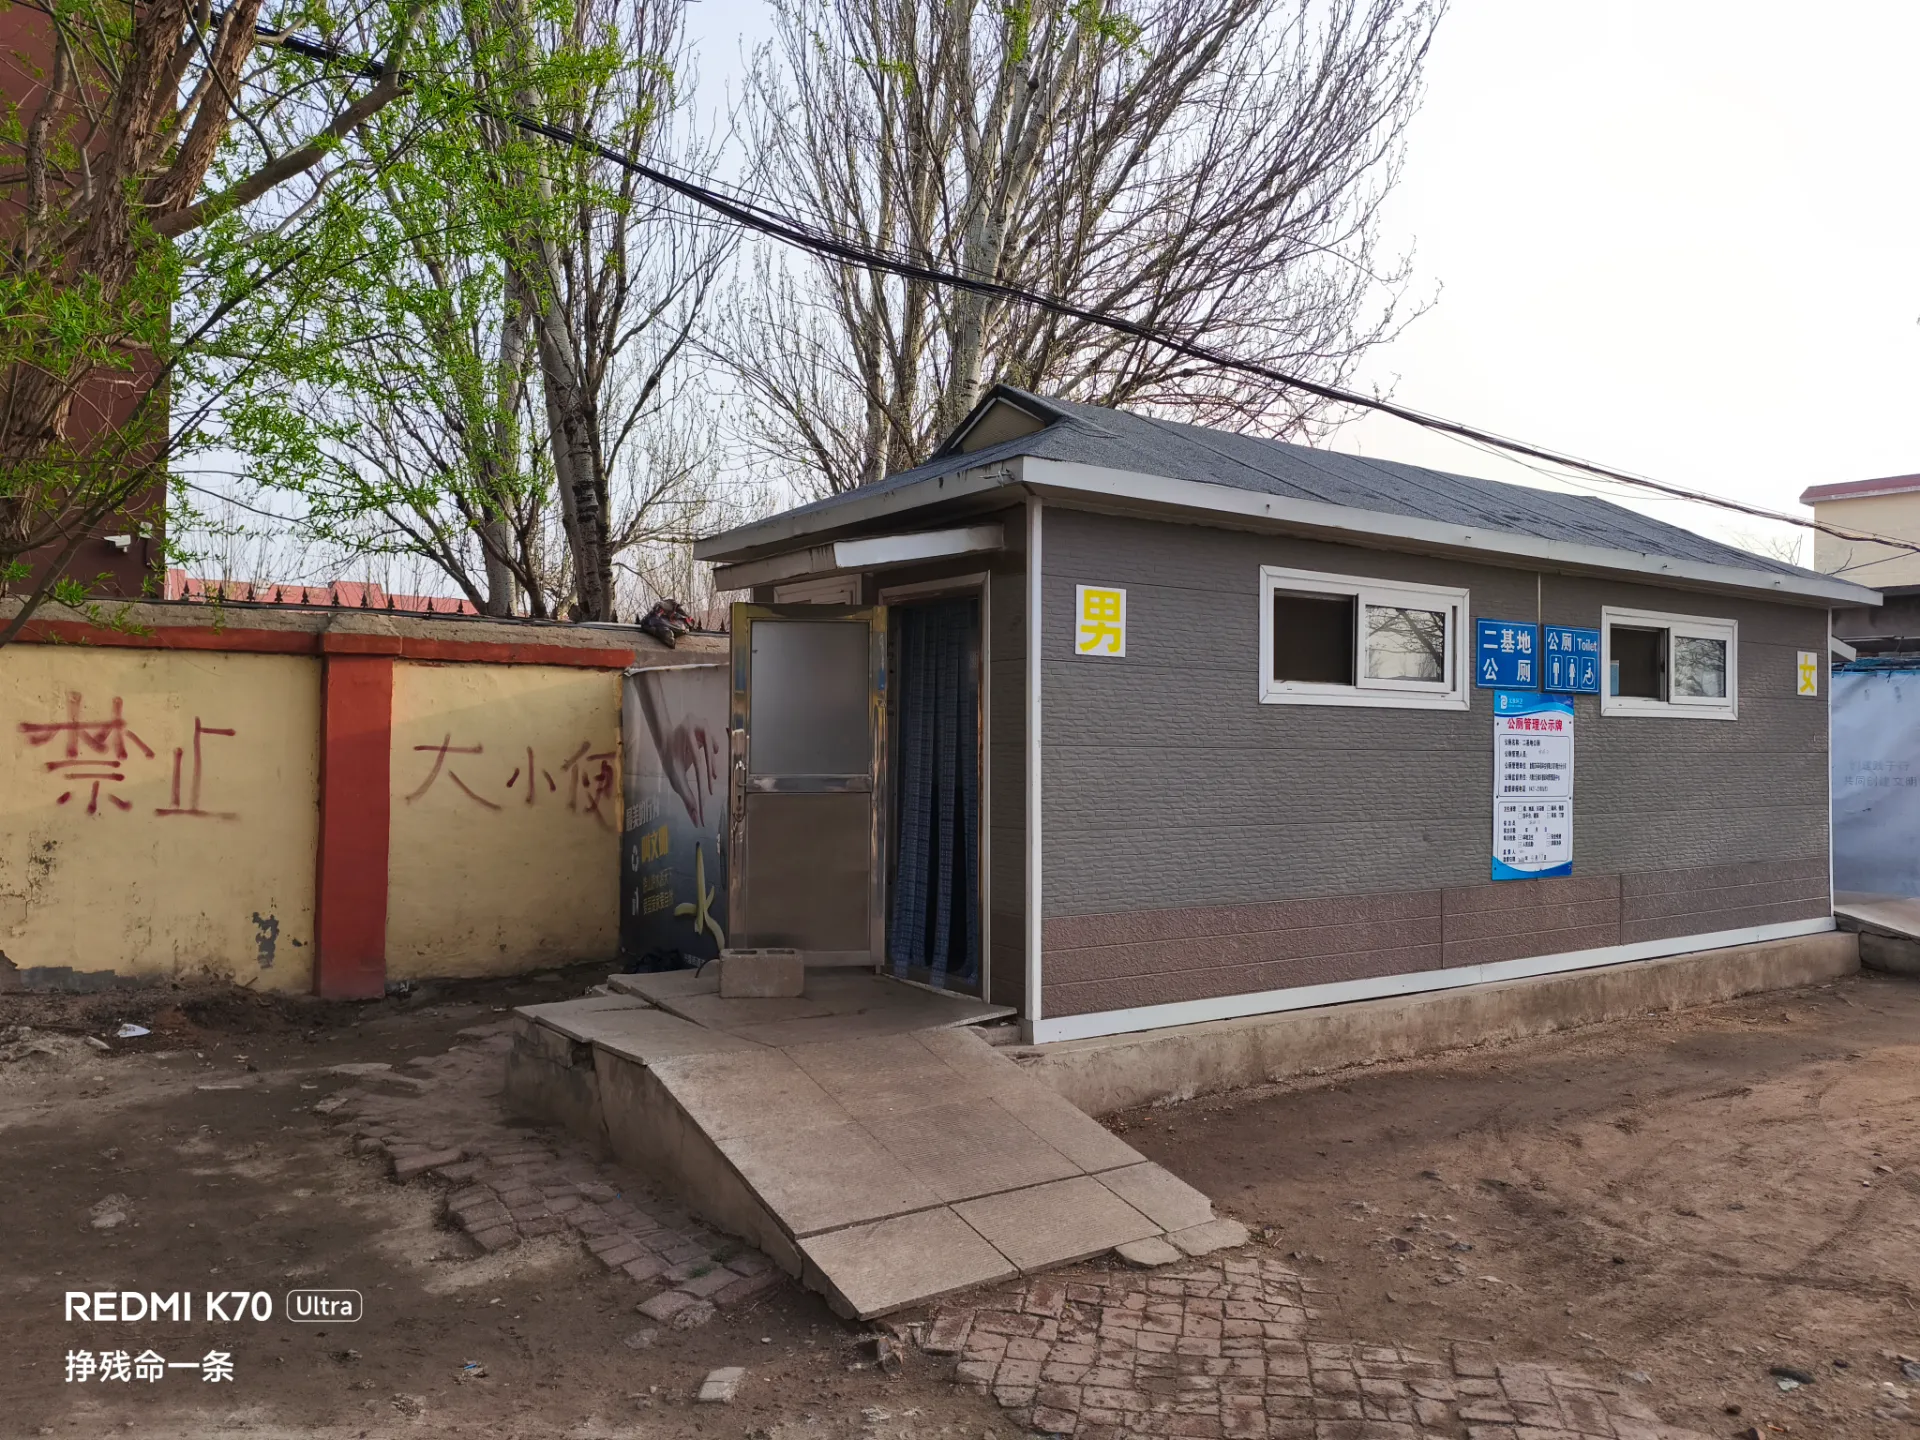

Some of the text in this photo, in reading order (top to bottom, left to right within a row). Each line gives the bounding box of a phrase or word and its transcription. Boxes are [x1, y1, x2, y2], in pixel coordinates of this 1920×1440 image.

[1079, 589, 1121, 653] 男
[1483, 628, 1532, 654] 二基地
[1547, 631, 1597, 652] 公厕 Toilet
[1483, 657, 1531, 682] 公厕
[1799, 654, 1816, 692] 女
[1507, 717, 1563, 731] 公厕管理公示牌
[19, 692, 620, 834] 禁止 大小便
